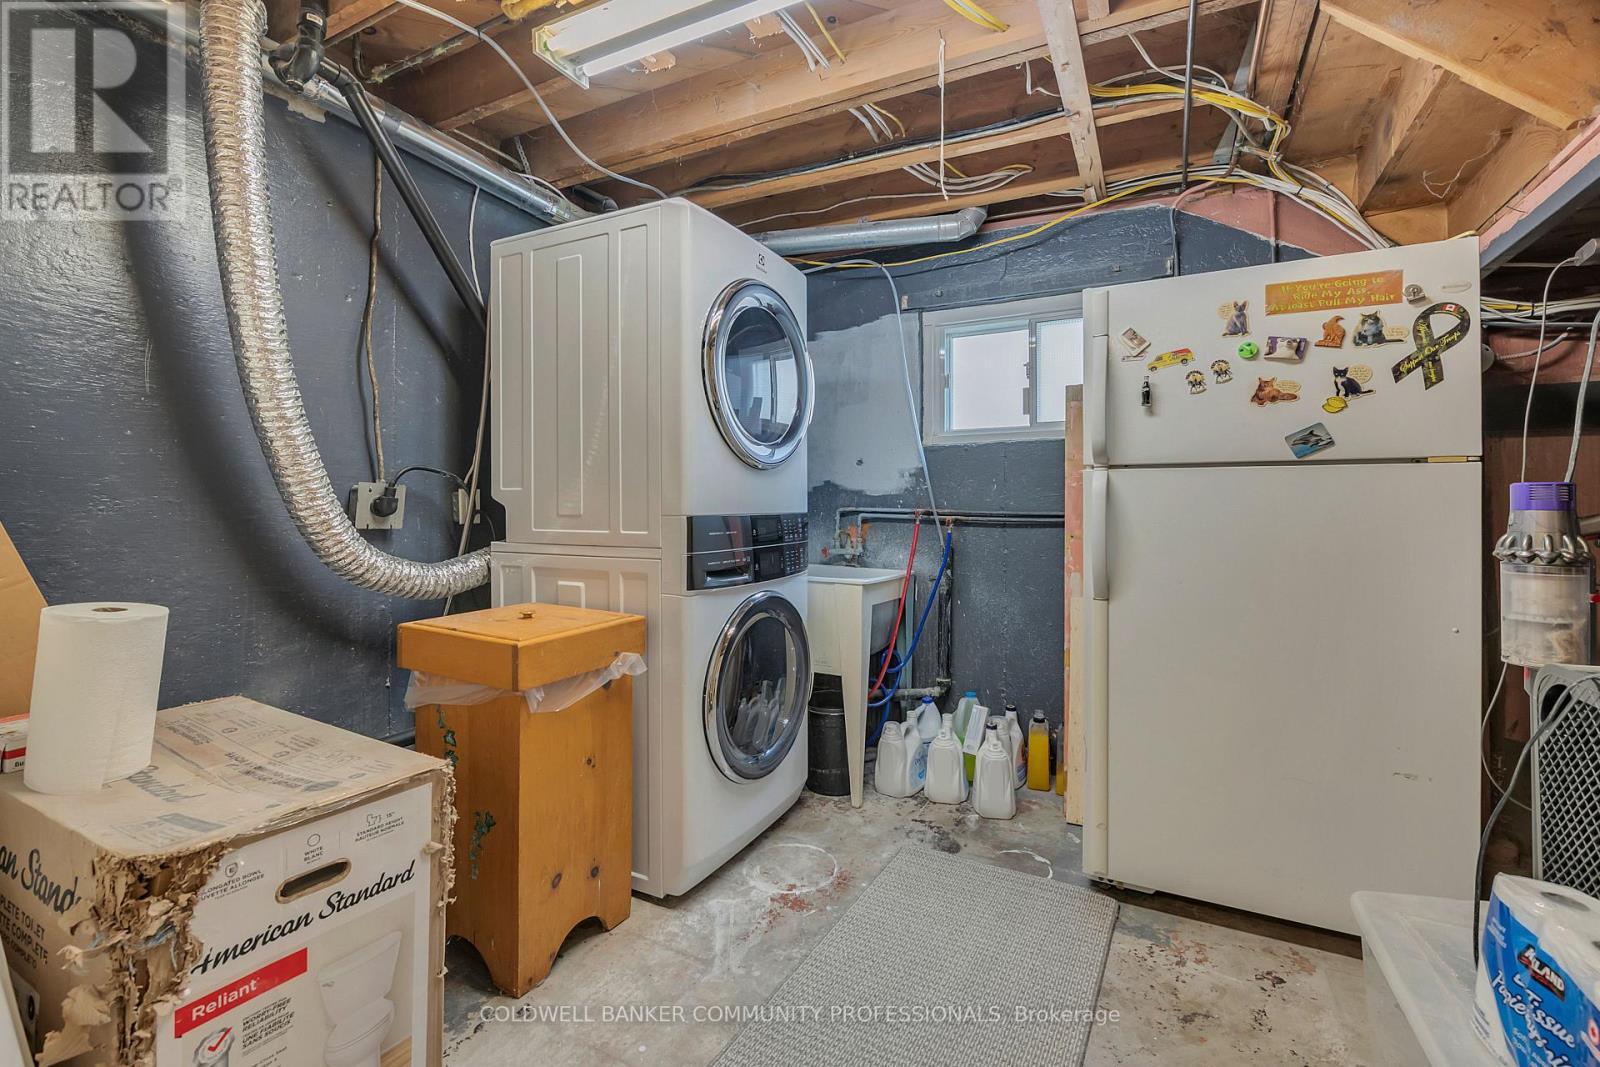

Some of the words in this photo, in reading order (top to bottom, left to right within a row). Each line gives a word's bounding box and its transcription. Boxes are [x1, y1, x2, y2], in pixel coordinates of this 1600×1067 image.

[1321, 288, 1341, 299] My
[1344, 295, 1366, 306] My
[303, 851, 324, 863] BLANC
[304, 846, 324, 857] WHITE
[318, 859, 416, 920] Standard
[191, 979, 258, 1021] Reliant
